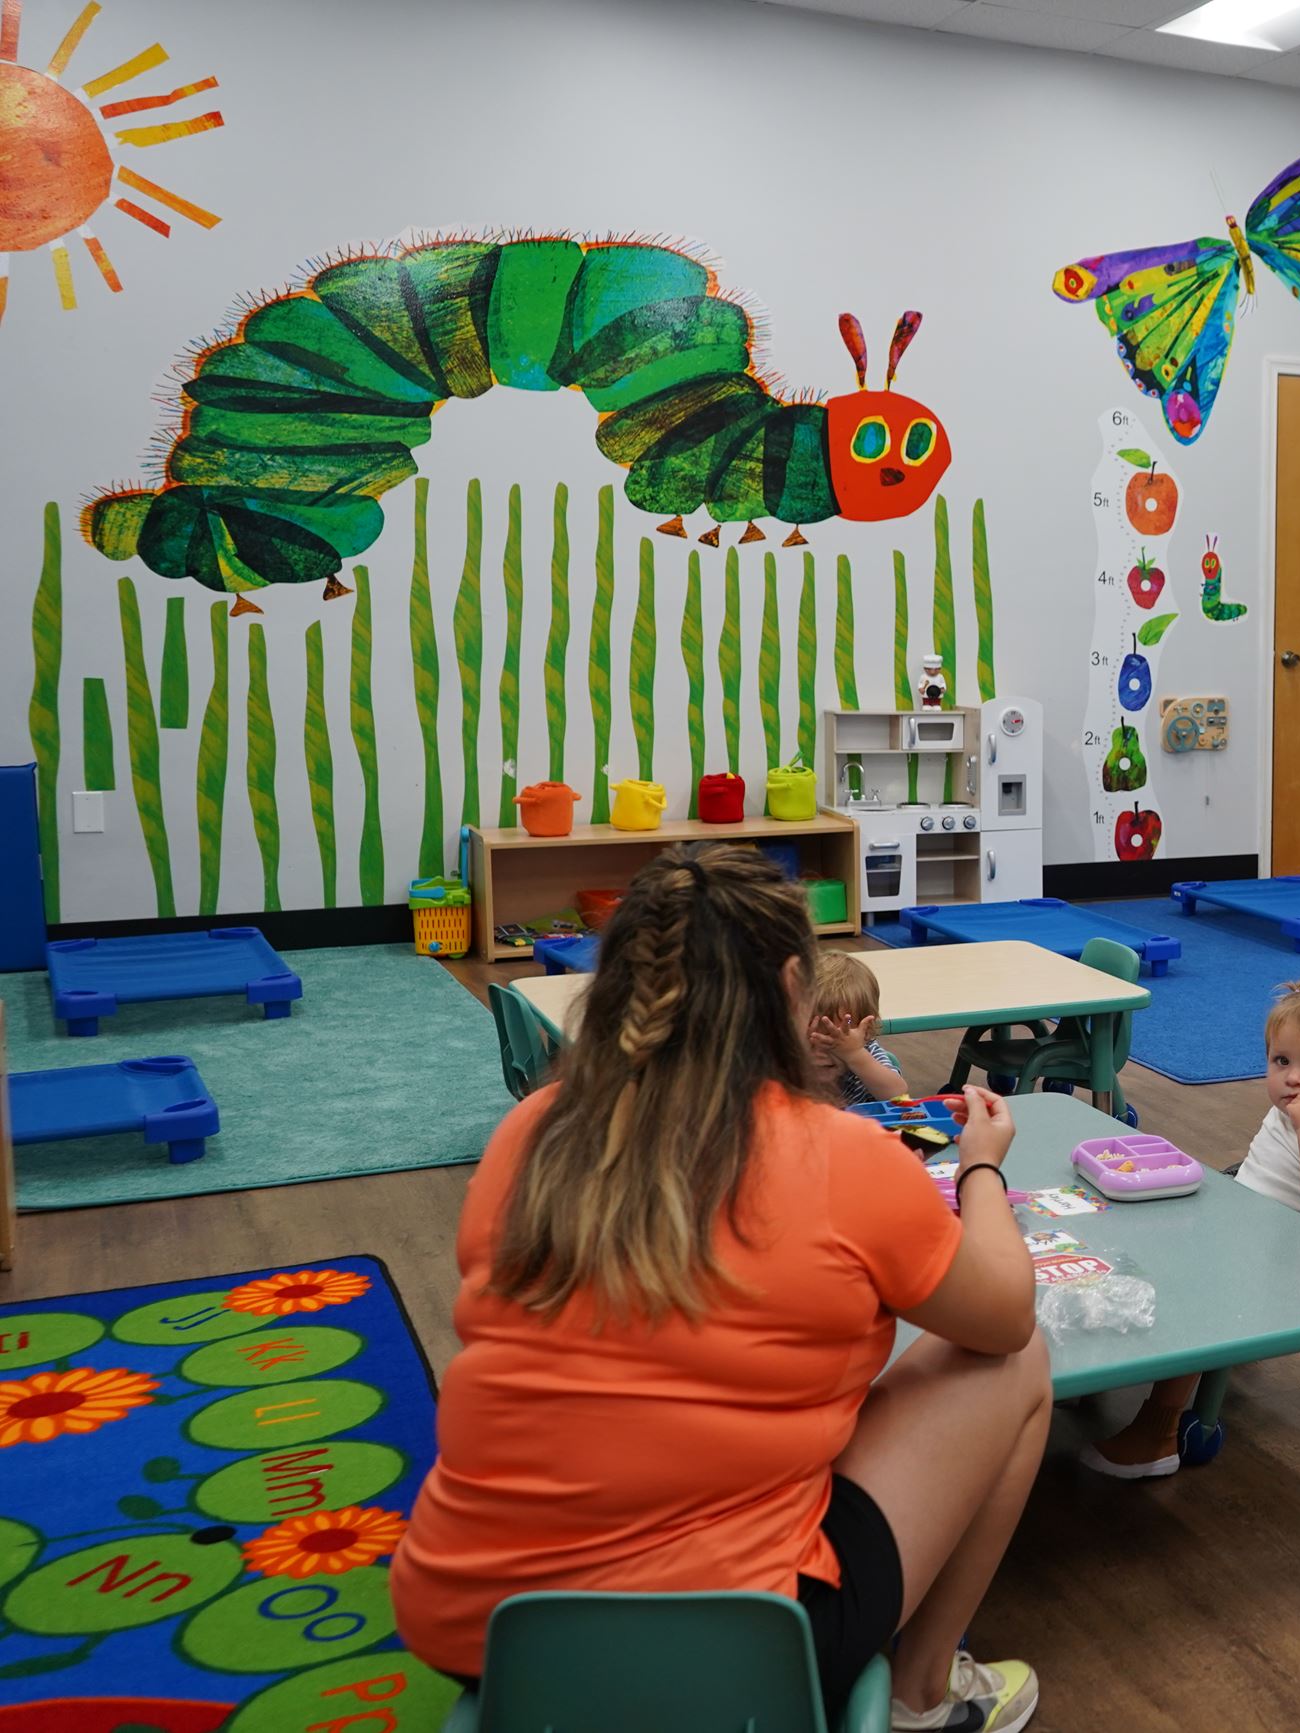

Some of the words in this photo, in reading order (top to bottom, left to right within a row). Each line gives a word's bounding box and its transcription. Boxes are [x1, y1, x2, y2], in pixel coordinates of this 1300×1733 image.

[1112, 410, 1129, 426] 6ft
[1093, 492, 1110, 508] 5ft
[1097, 570, 1115, 586] 4ft
[1084, 731, 1101, 746] 2ft
[65, 1554, 192, 1603] Nn
[257, 1584, 367, 1642] Oo
